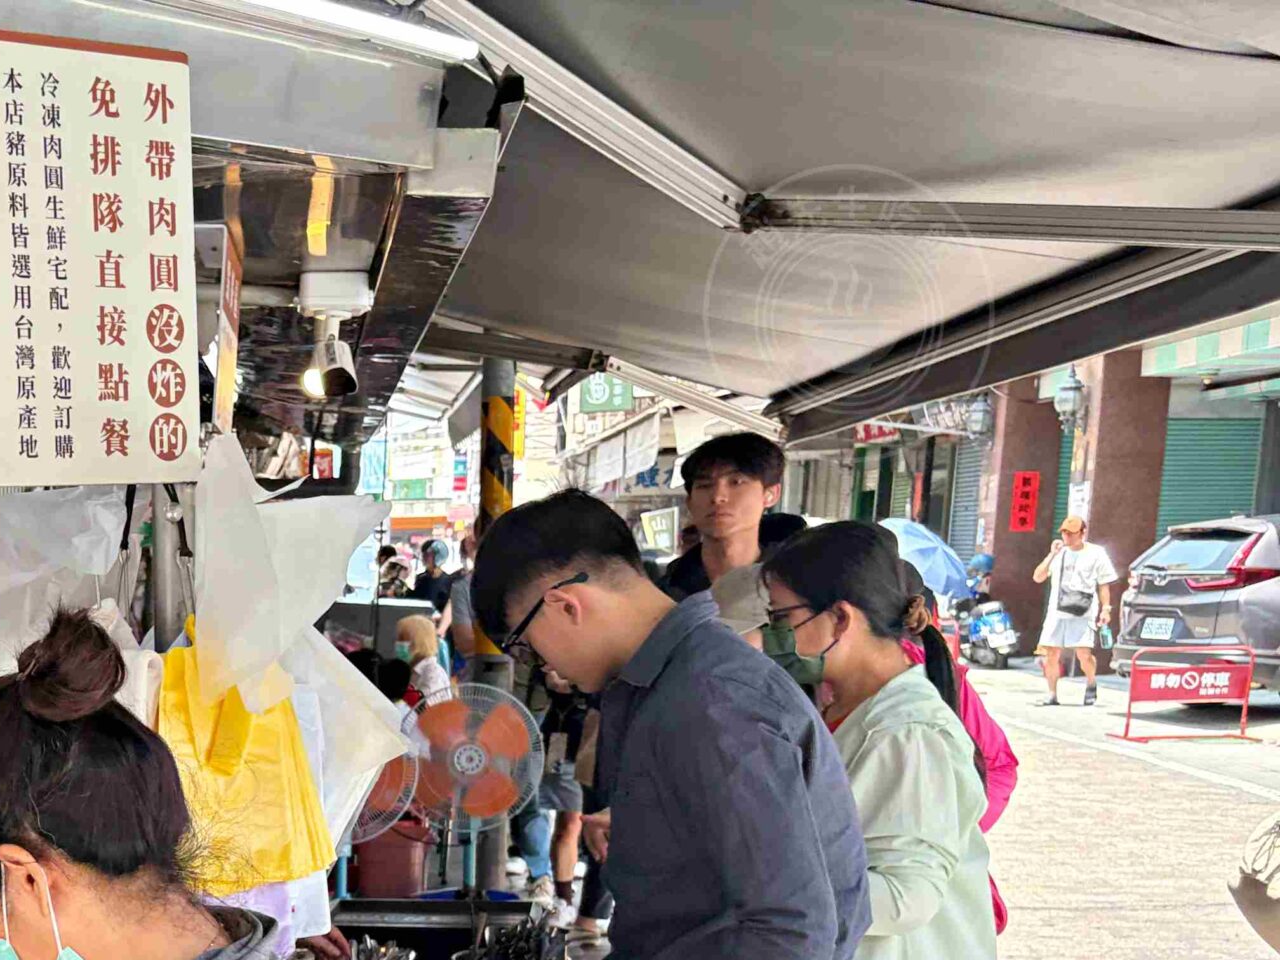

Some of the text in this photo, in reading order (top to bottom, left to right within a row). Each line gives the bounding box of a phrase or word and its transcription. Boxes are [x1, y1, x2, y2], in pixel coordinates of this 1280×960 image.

[3, 68, 38, 459] 本店豬原料皆選用台灣原產地
[40, 72, 74, 459] 冷凍肉圓生鮮宅配，歡迎訂購
[89, 76, 131, 458] 免排隊直接點餐
[144, 82, 186, 459] 外帶肉圓沒炸的
